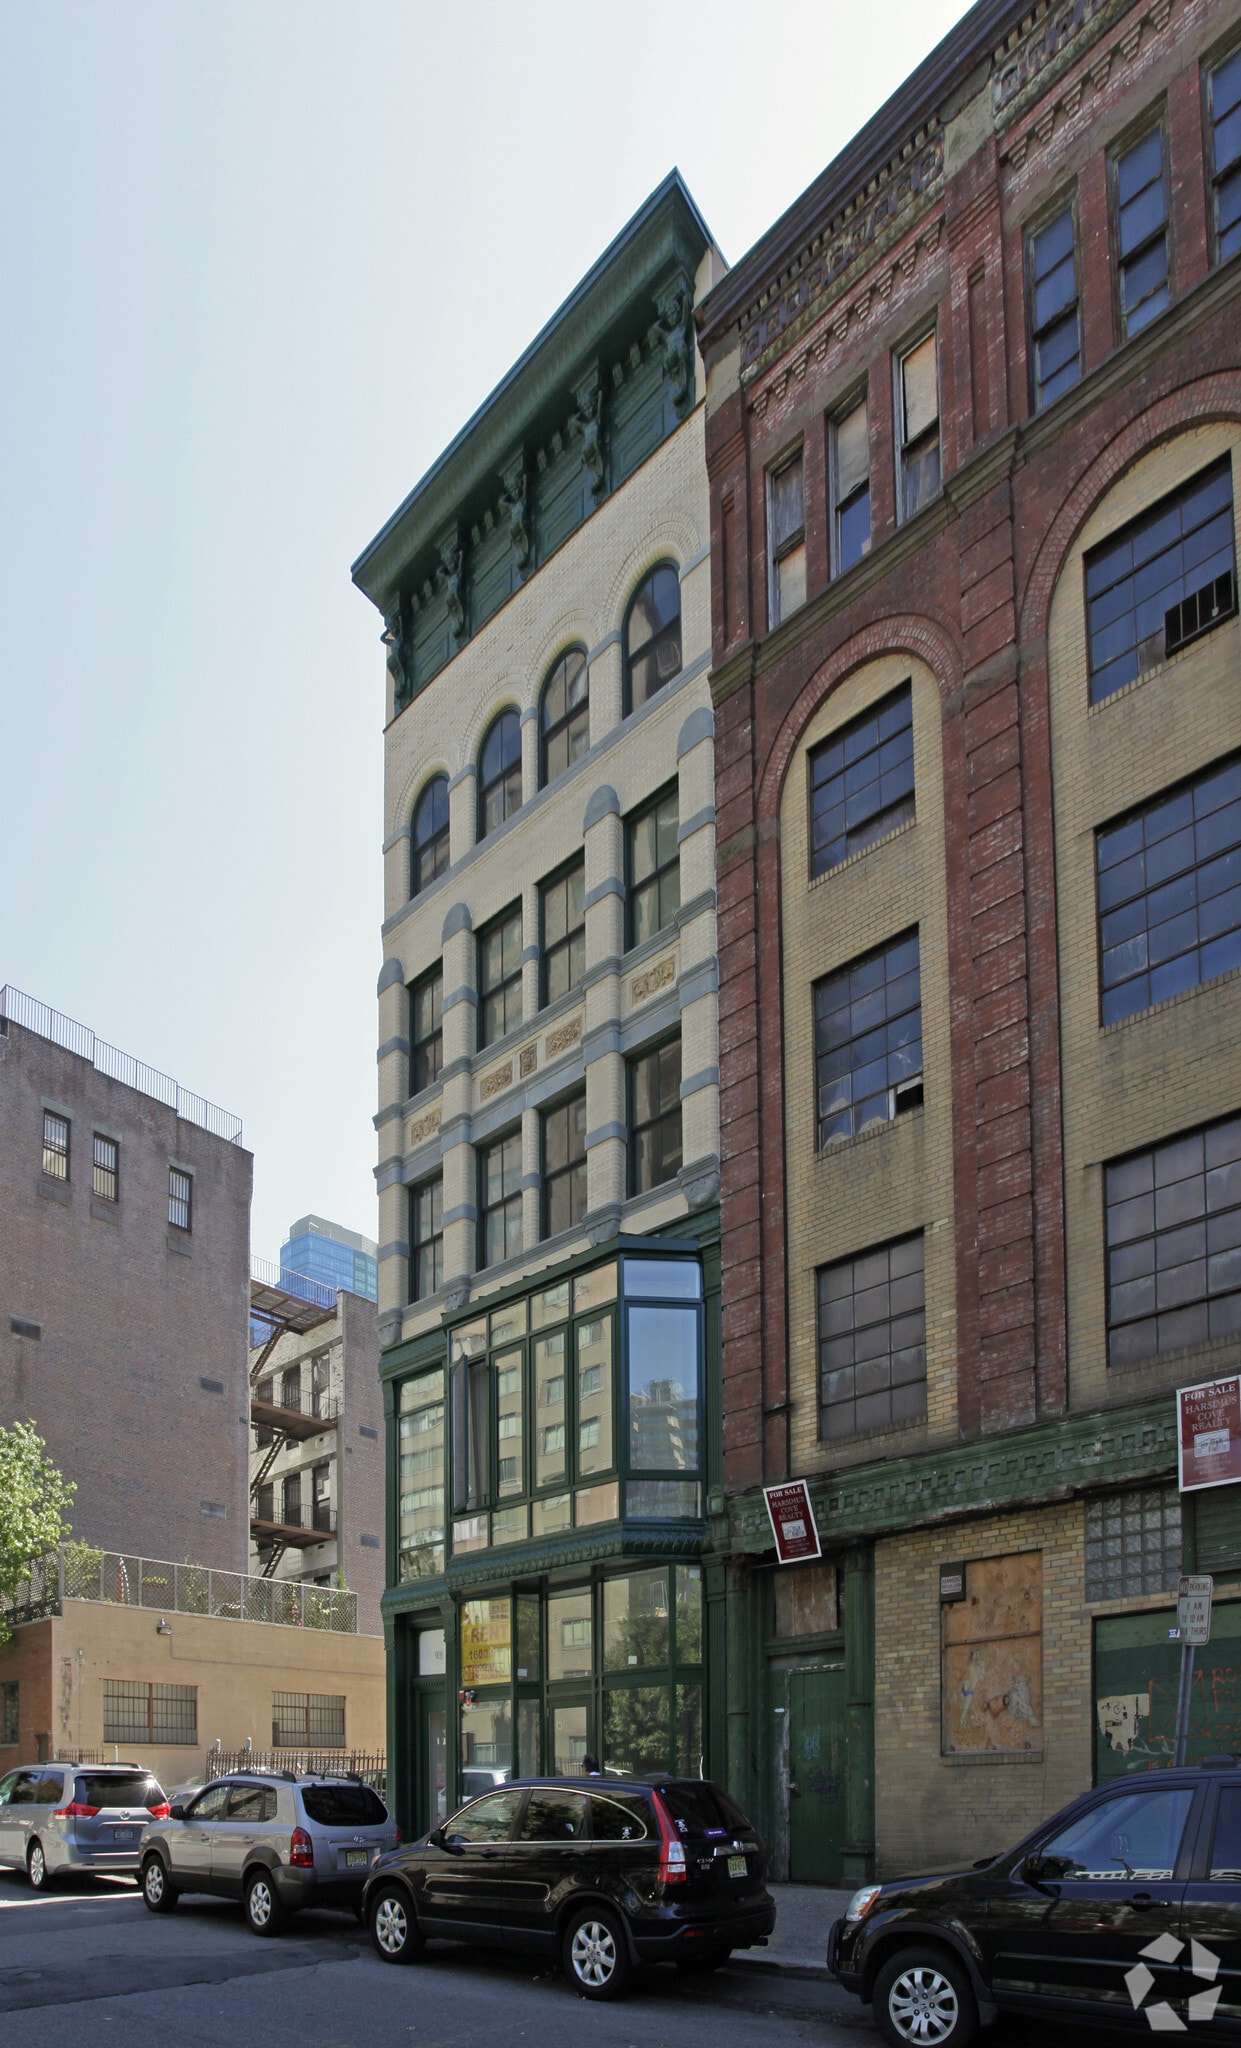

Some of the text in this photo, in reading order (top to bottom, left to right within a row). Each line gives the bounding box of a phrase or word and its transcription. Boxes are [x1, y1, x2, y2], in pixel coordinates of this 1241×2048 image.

[1184, 1383, 1236, 1402] FOR SALE
[1185, 1396, 1237, 1414] HARSIMUS
[1197, 1409, 1225, 1422] COVE
[1192, 1416, 1231, 1432] REALTY
[769, 1486, 803, 1499] FOR SALE
[772, 1496, 805, 1508] HARSIMUS
[780, 1504, 799, 1514] COVE
[778, 1510, 804, 1521] REALTY
[1189, 1582, 1209, 1591] PARKING
[1193, 1601, 1203, 1611] AM
[1196, 1613, 1205, 1623] AM
[470, 1623, 509, 1644] RENT
